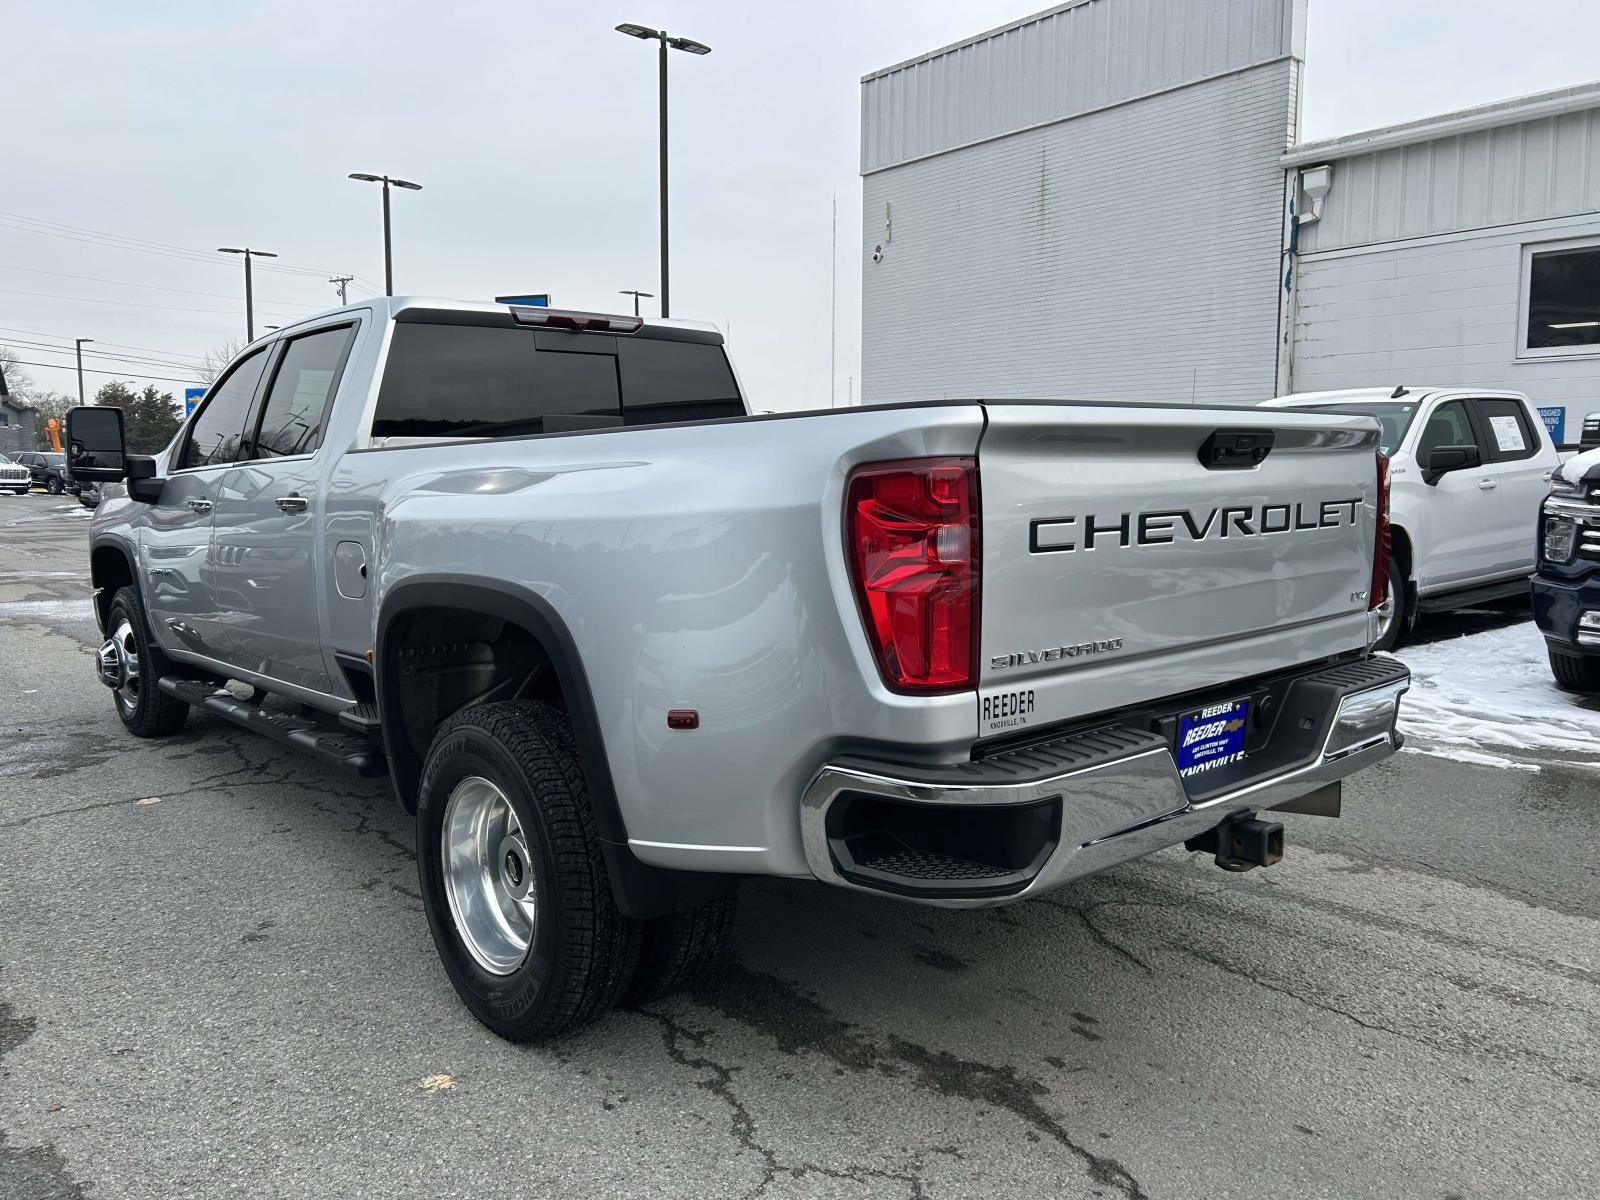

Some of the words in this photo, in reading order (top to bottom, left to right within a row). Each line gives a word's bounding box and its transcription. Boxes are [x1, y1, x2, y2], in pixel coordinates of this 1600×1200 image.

[1029, 498, 1363, 555] CHEVROLET
[991, 638, 1123, 670] SILVERADO
[983, 690, 1035, 720] REEDER
[1201, 702, 1233, 719] REEDER
[1182, 720, 1227, 748] REEDER
